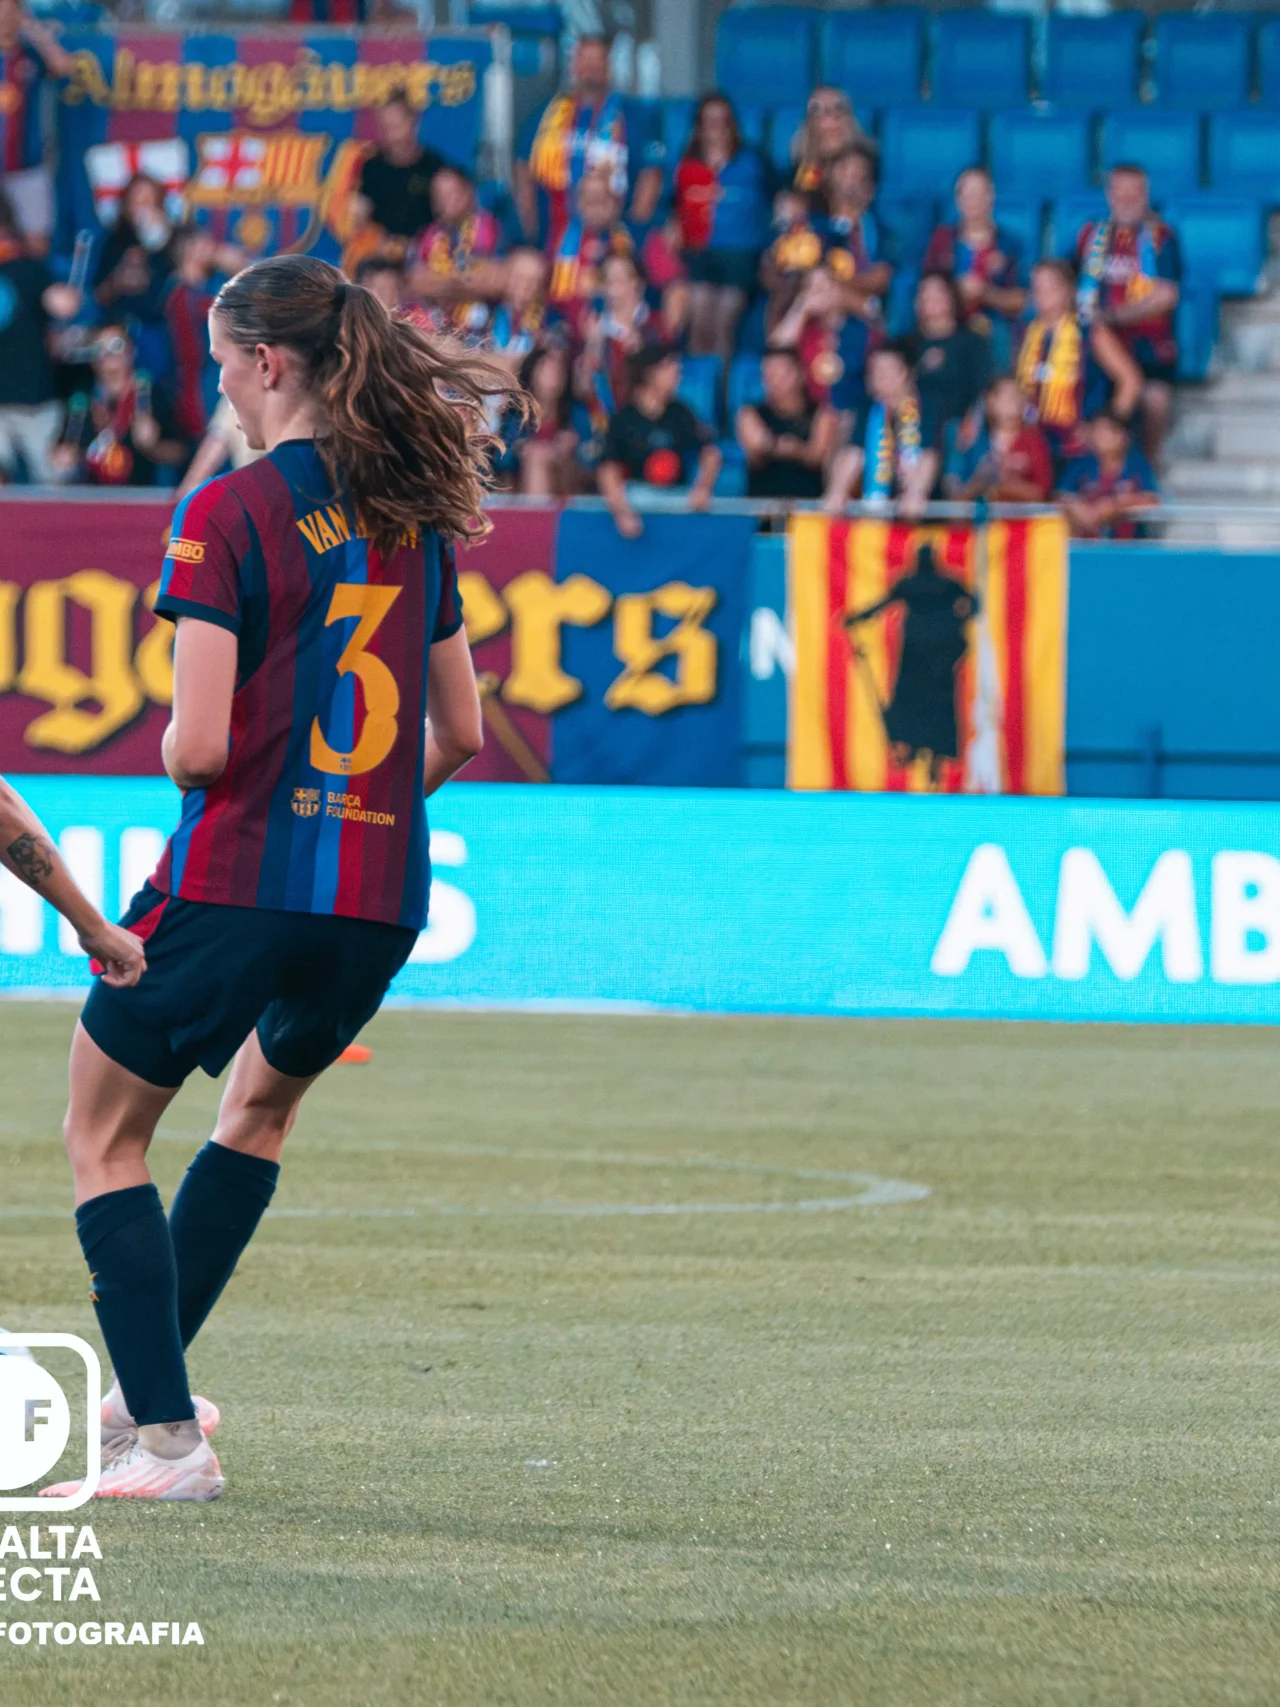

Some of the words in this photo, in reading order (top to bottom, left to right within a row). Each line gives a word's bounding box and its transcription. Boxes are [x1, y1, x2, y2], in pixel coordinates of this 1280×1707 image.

[296, 503, 351, 555] VAN
[310, 583, 403, 776] 3
[325, 805, 396, 826] FOUNDATION
[327, 791, 362, 808] BARÇA
[931, 843, 1280, 983] AMB
